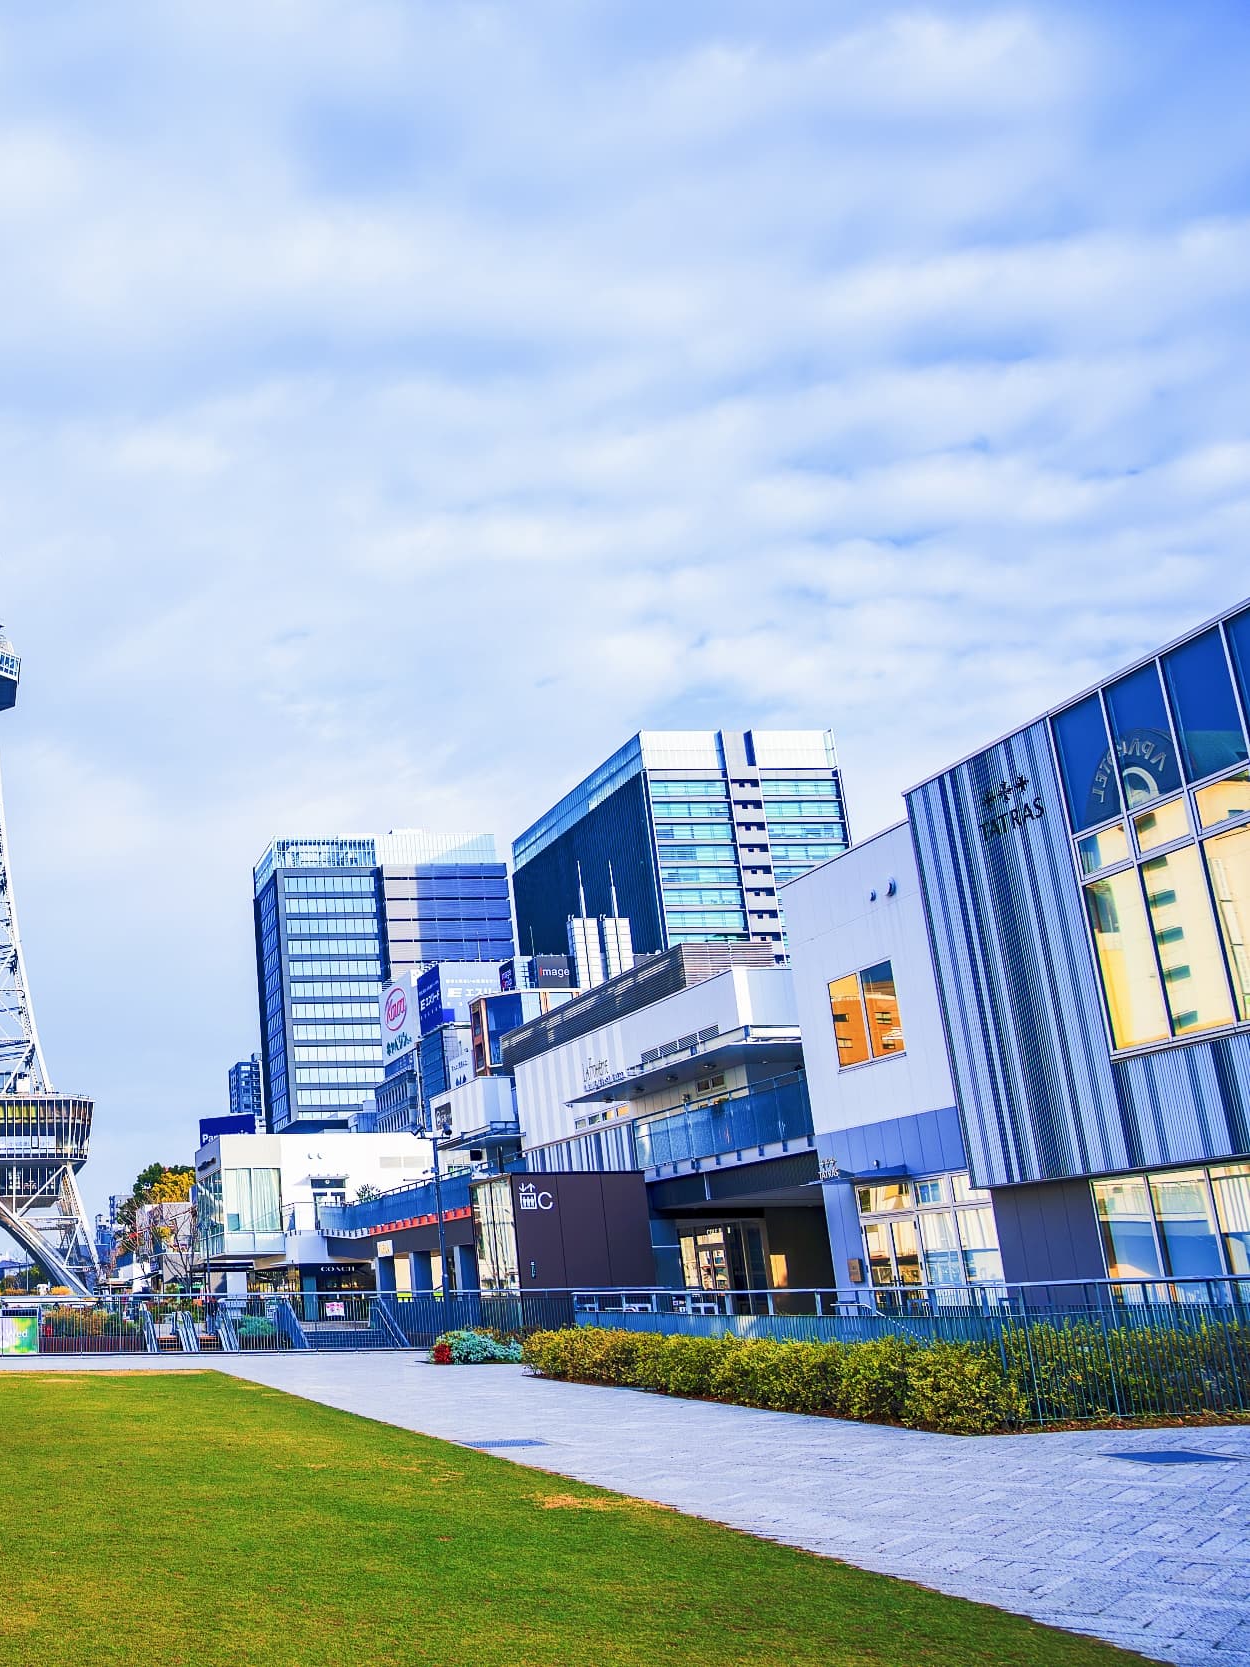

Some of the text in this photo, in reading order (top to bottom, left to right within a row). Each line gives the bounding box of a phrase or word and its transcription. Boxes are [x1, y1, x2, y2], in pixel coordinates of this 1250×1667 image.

[978, 797, 1044, 841] TATRAS
[539, 966, 570, 978] Image
[537, 1191, 554, 1210] C
